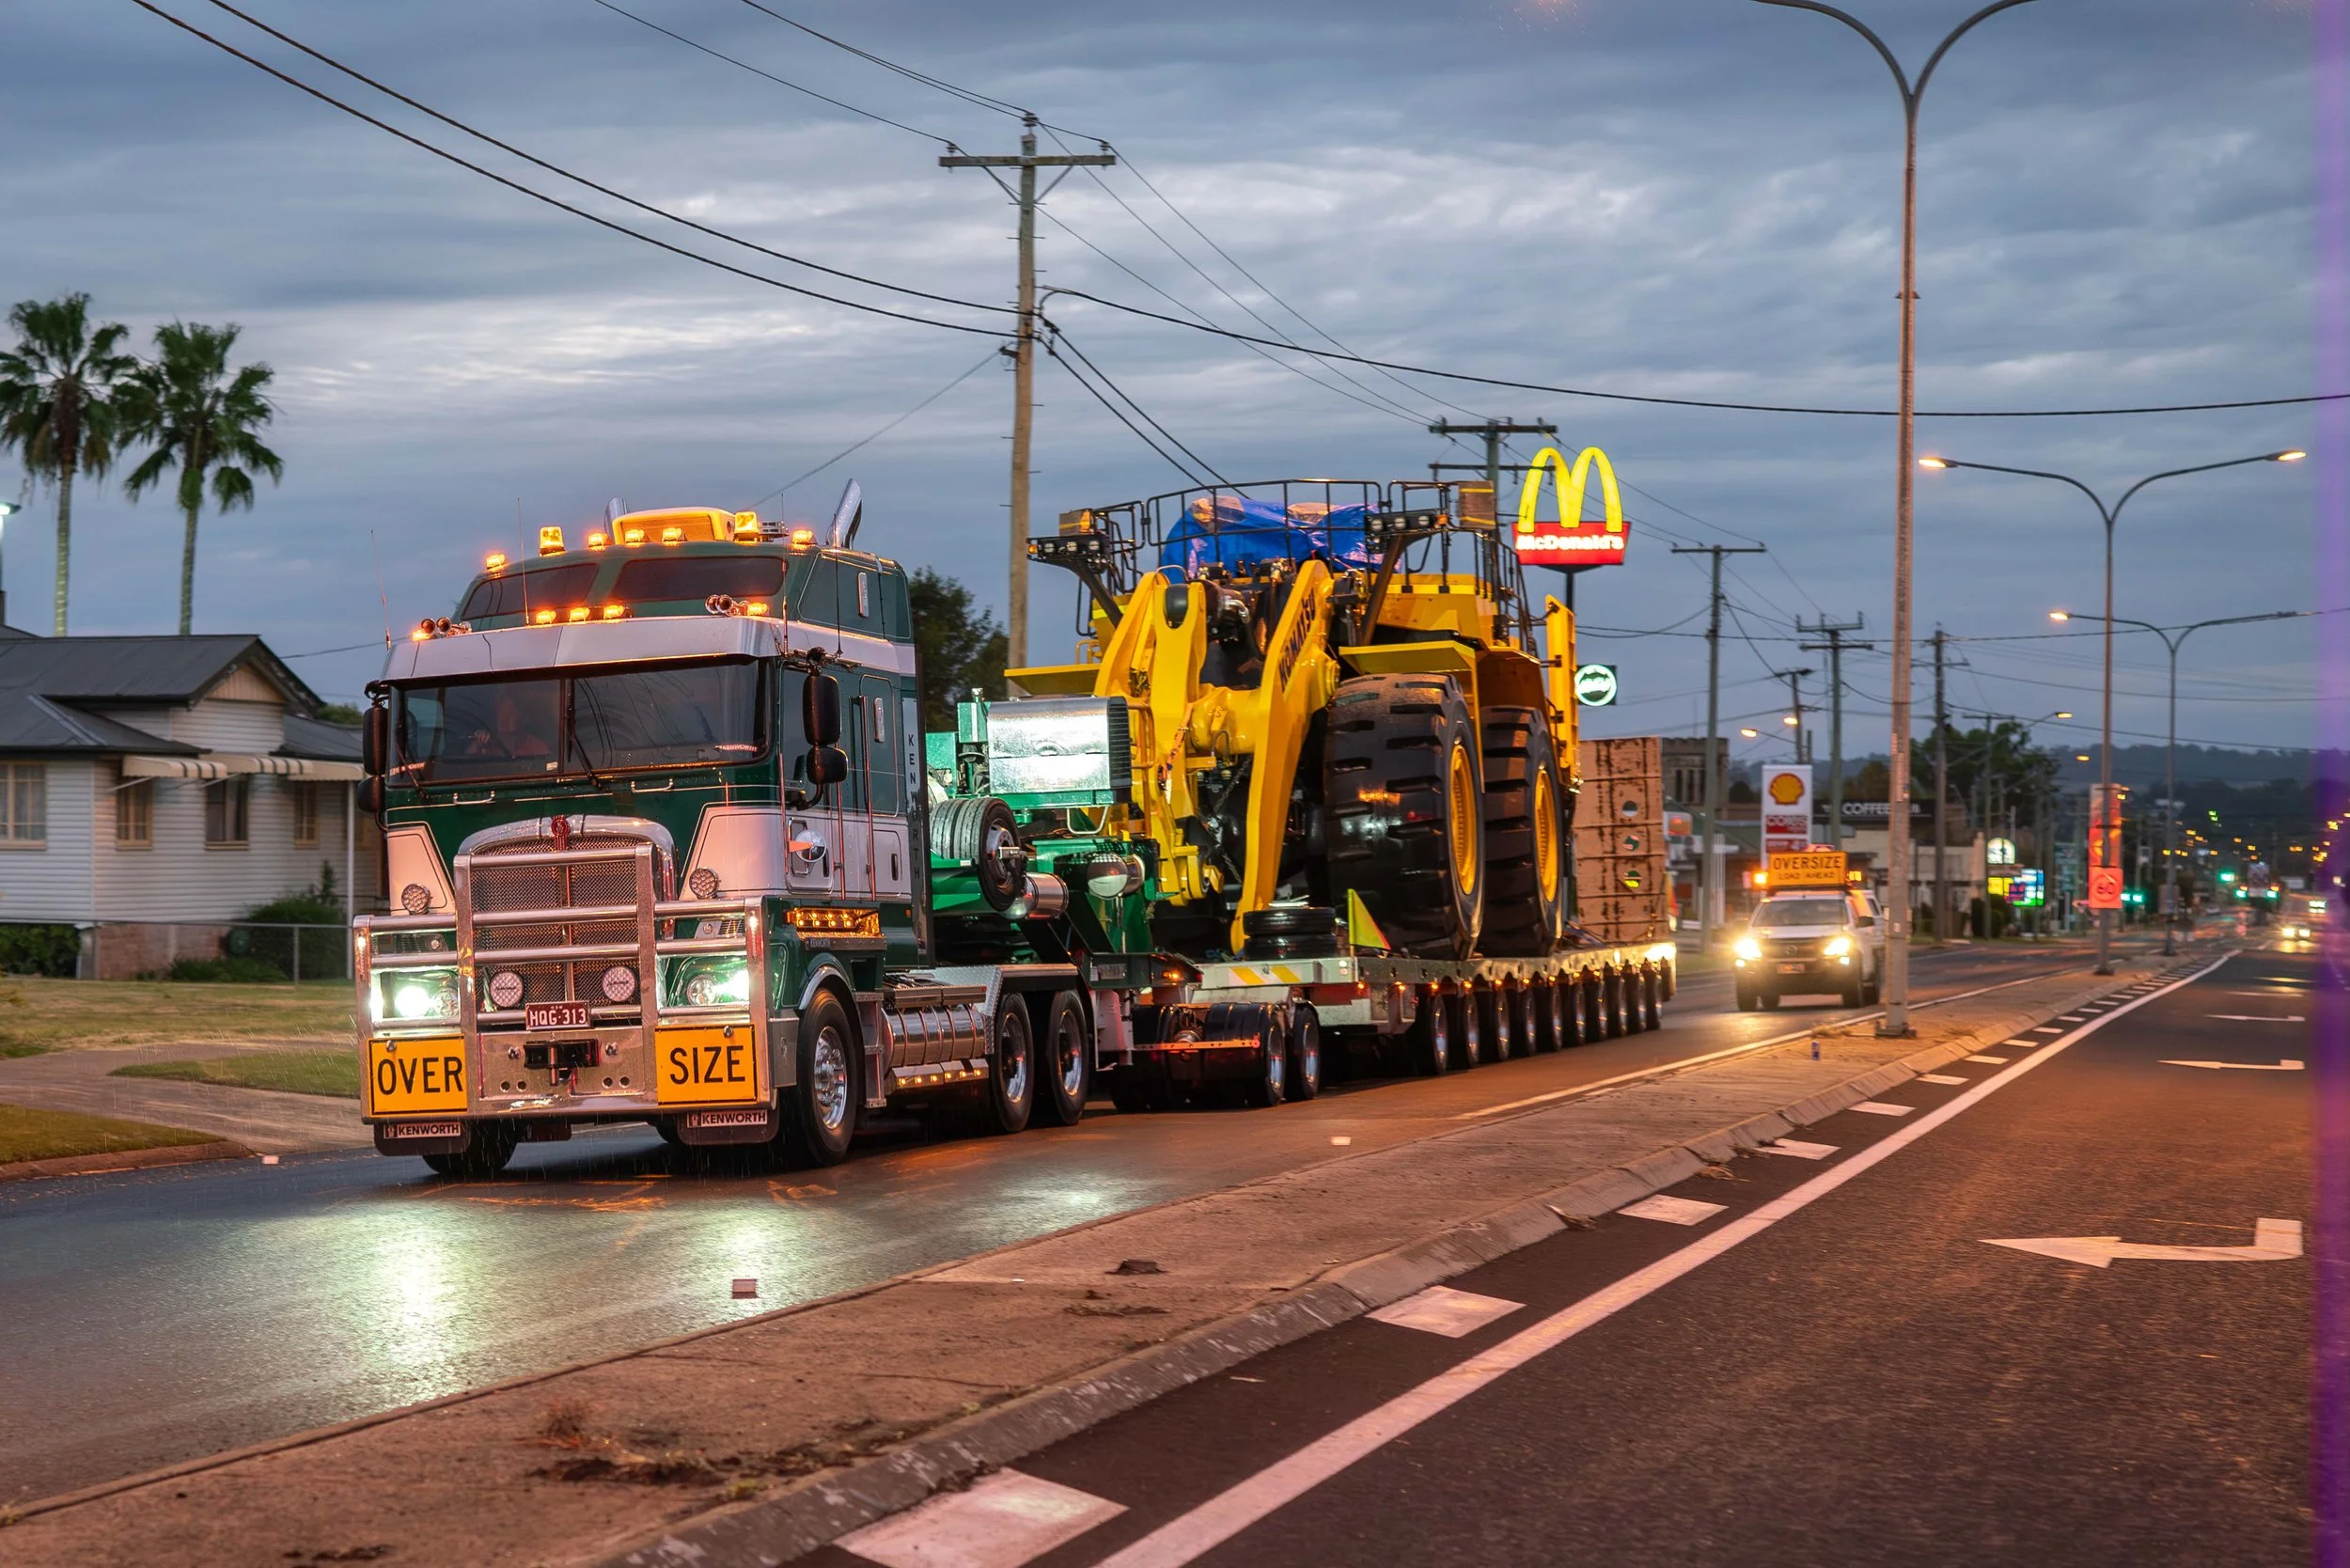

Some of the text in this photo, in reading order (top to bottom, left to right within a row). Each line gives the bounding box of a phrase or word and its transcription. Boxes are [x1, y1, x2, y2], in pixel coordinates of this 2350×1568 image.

[1278, 588, 1315, 693] KOMATSU
[908, 733, 920, 879] KENWORTH
[1773, 856, 1841, 870] OVERSIZE
[377, 1057, 463, 1095] OVER
[669, 1045, 746, 1085] SIZE
[398, 1124, 460, 1136] KENWORTH
[702, 1113, 766, 1125] KENWORTH
